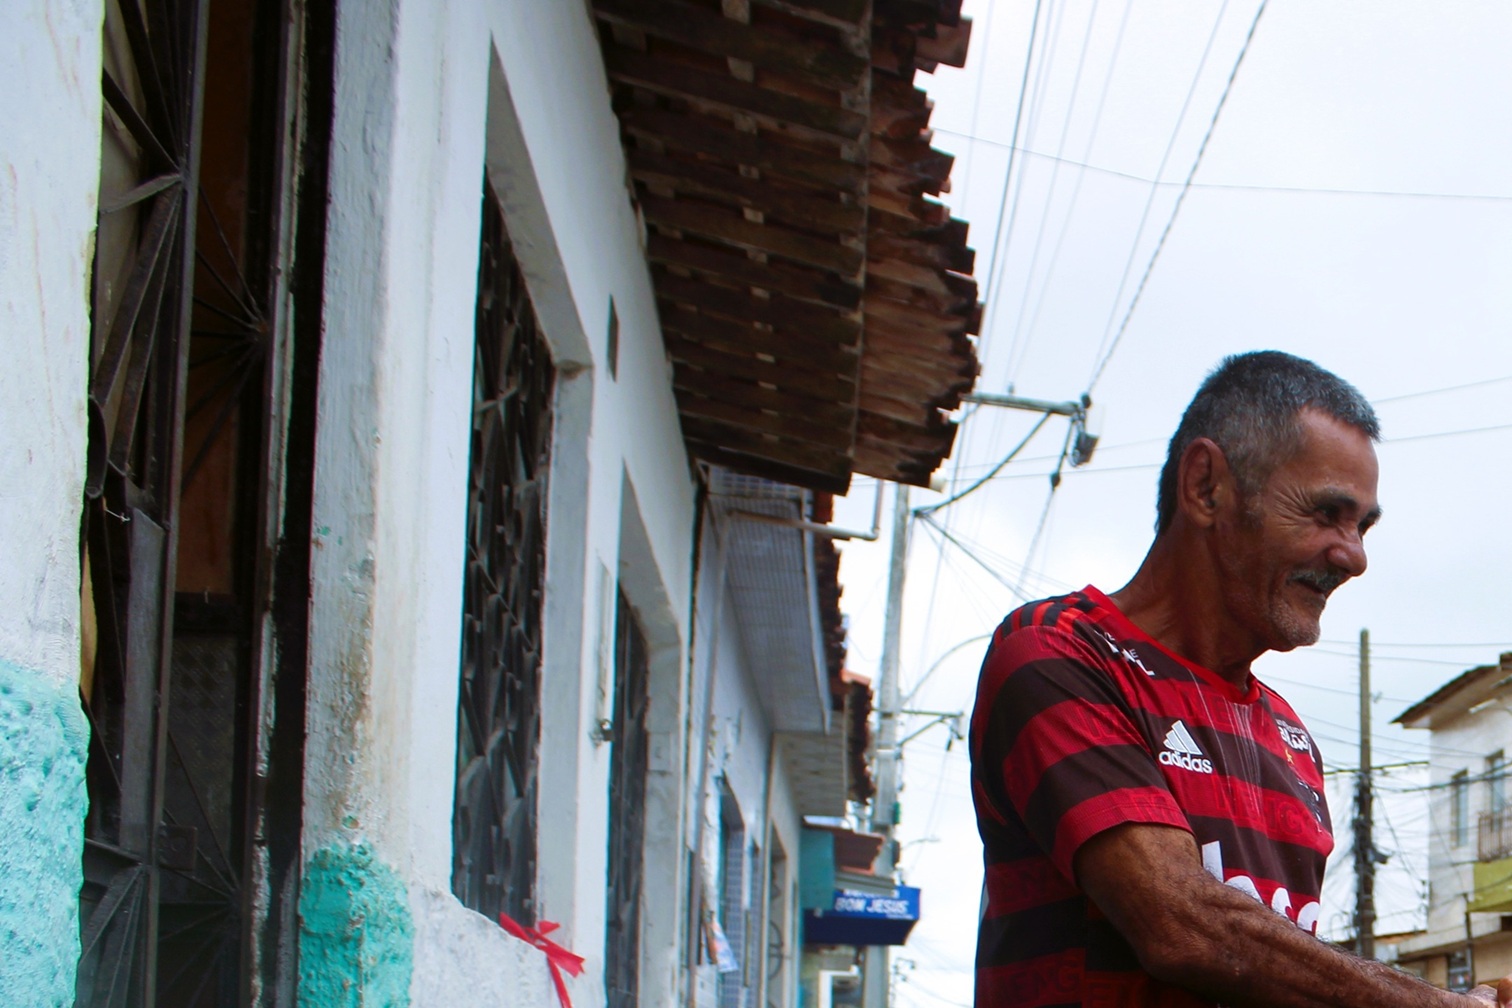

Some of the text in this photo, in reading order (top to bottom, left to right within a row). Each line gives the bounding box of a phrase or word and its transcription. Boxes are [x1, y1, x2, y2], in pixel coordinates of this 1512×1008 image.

[1159, 749, 1213, 774] adidas
[834, 897, 909, 915] BOM JESUS
